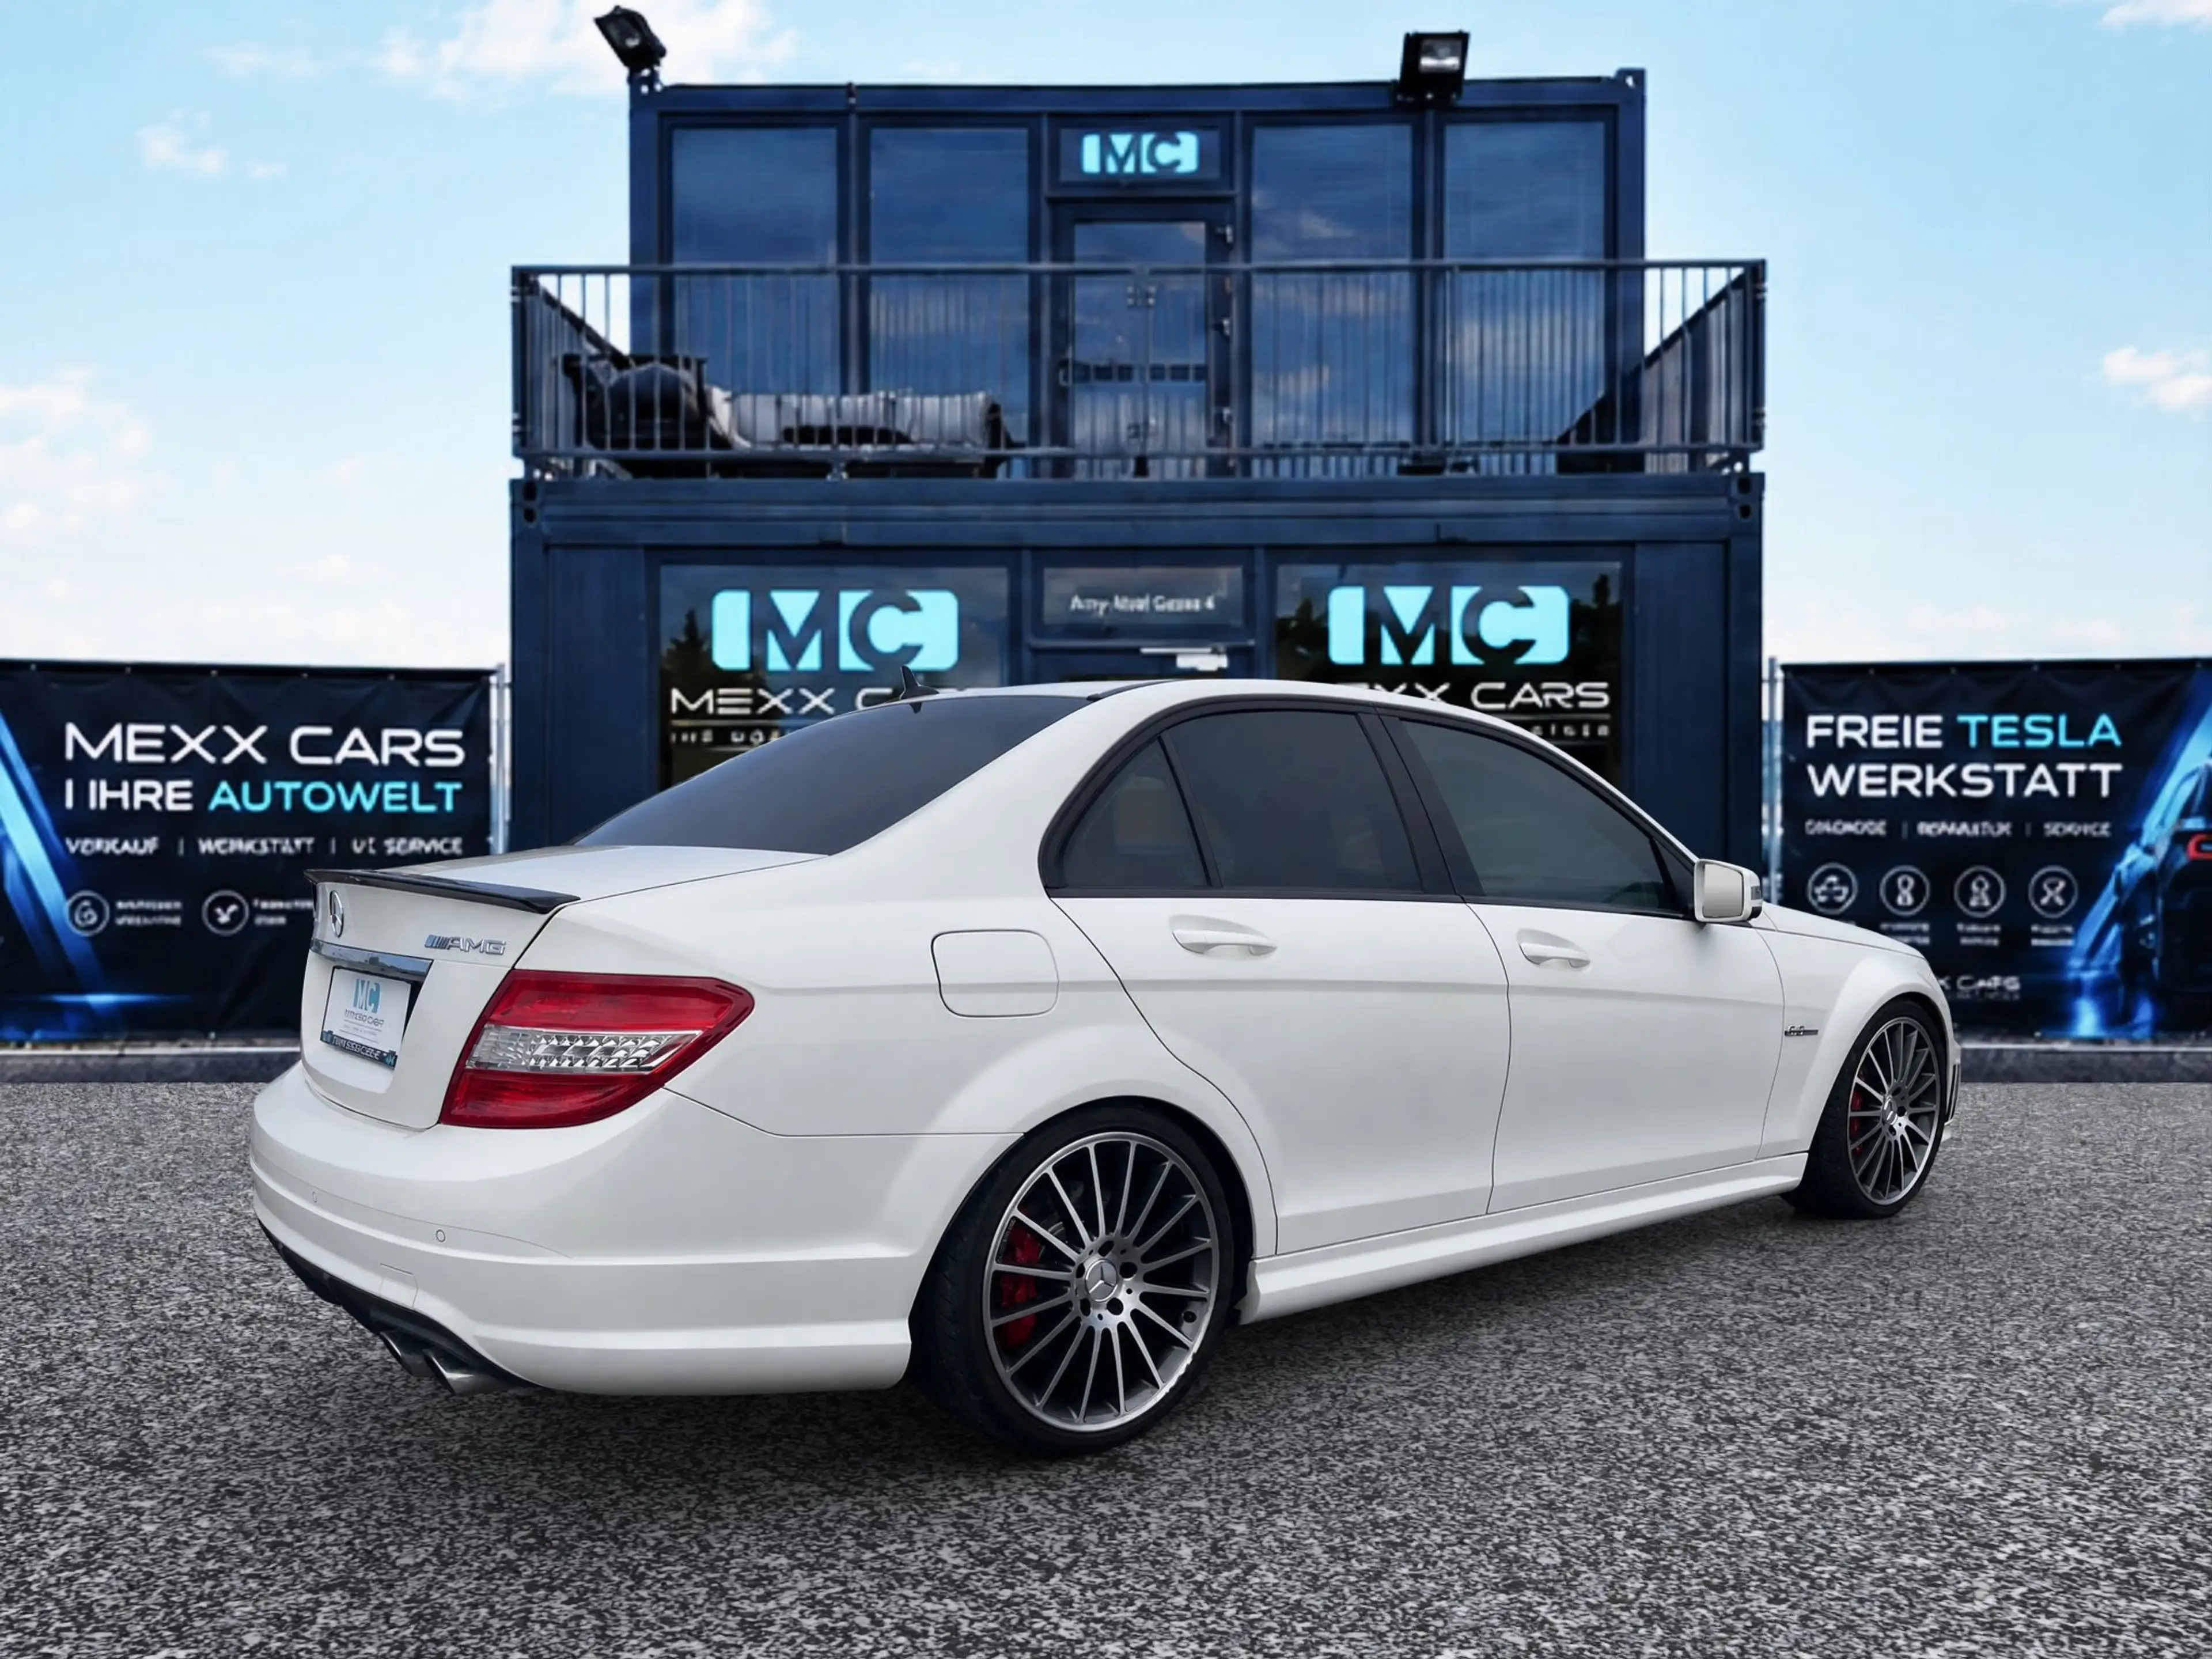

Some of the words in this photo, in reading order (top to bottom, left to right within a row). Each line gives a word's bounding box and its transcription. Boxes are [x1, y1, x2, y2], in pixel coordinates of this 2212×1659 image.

[671, 688, 835, 715] MEXX
[1471, 682, 1609, 709] CARS
[65, 722, 268, 764] MEXX
[290, 726, 465, 767] CARS
[1806, 714, 1943, 748] FREIE
[1957, 713, 2122, 748] TESLA
[89, 779, 193, 811] IHRE
[209, 781, 463, 813] AUTOWELT
[1807, 763, 2123, 798] WERKSTATT
[446, 936, 506, 956] AMG
